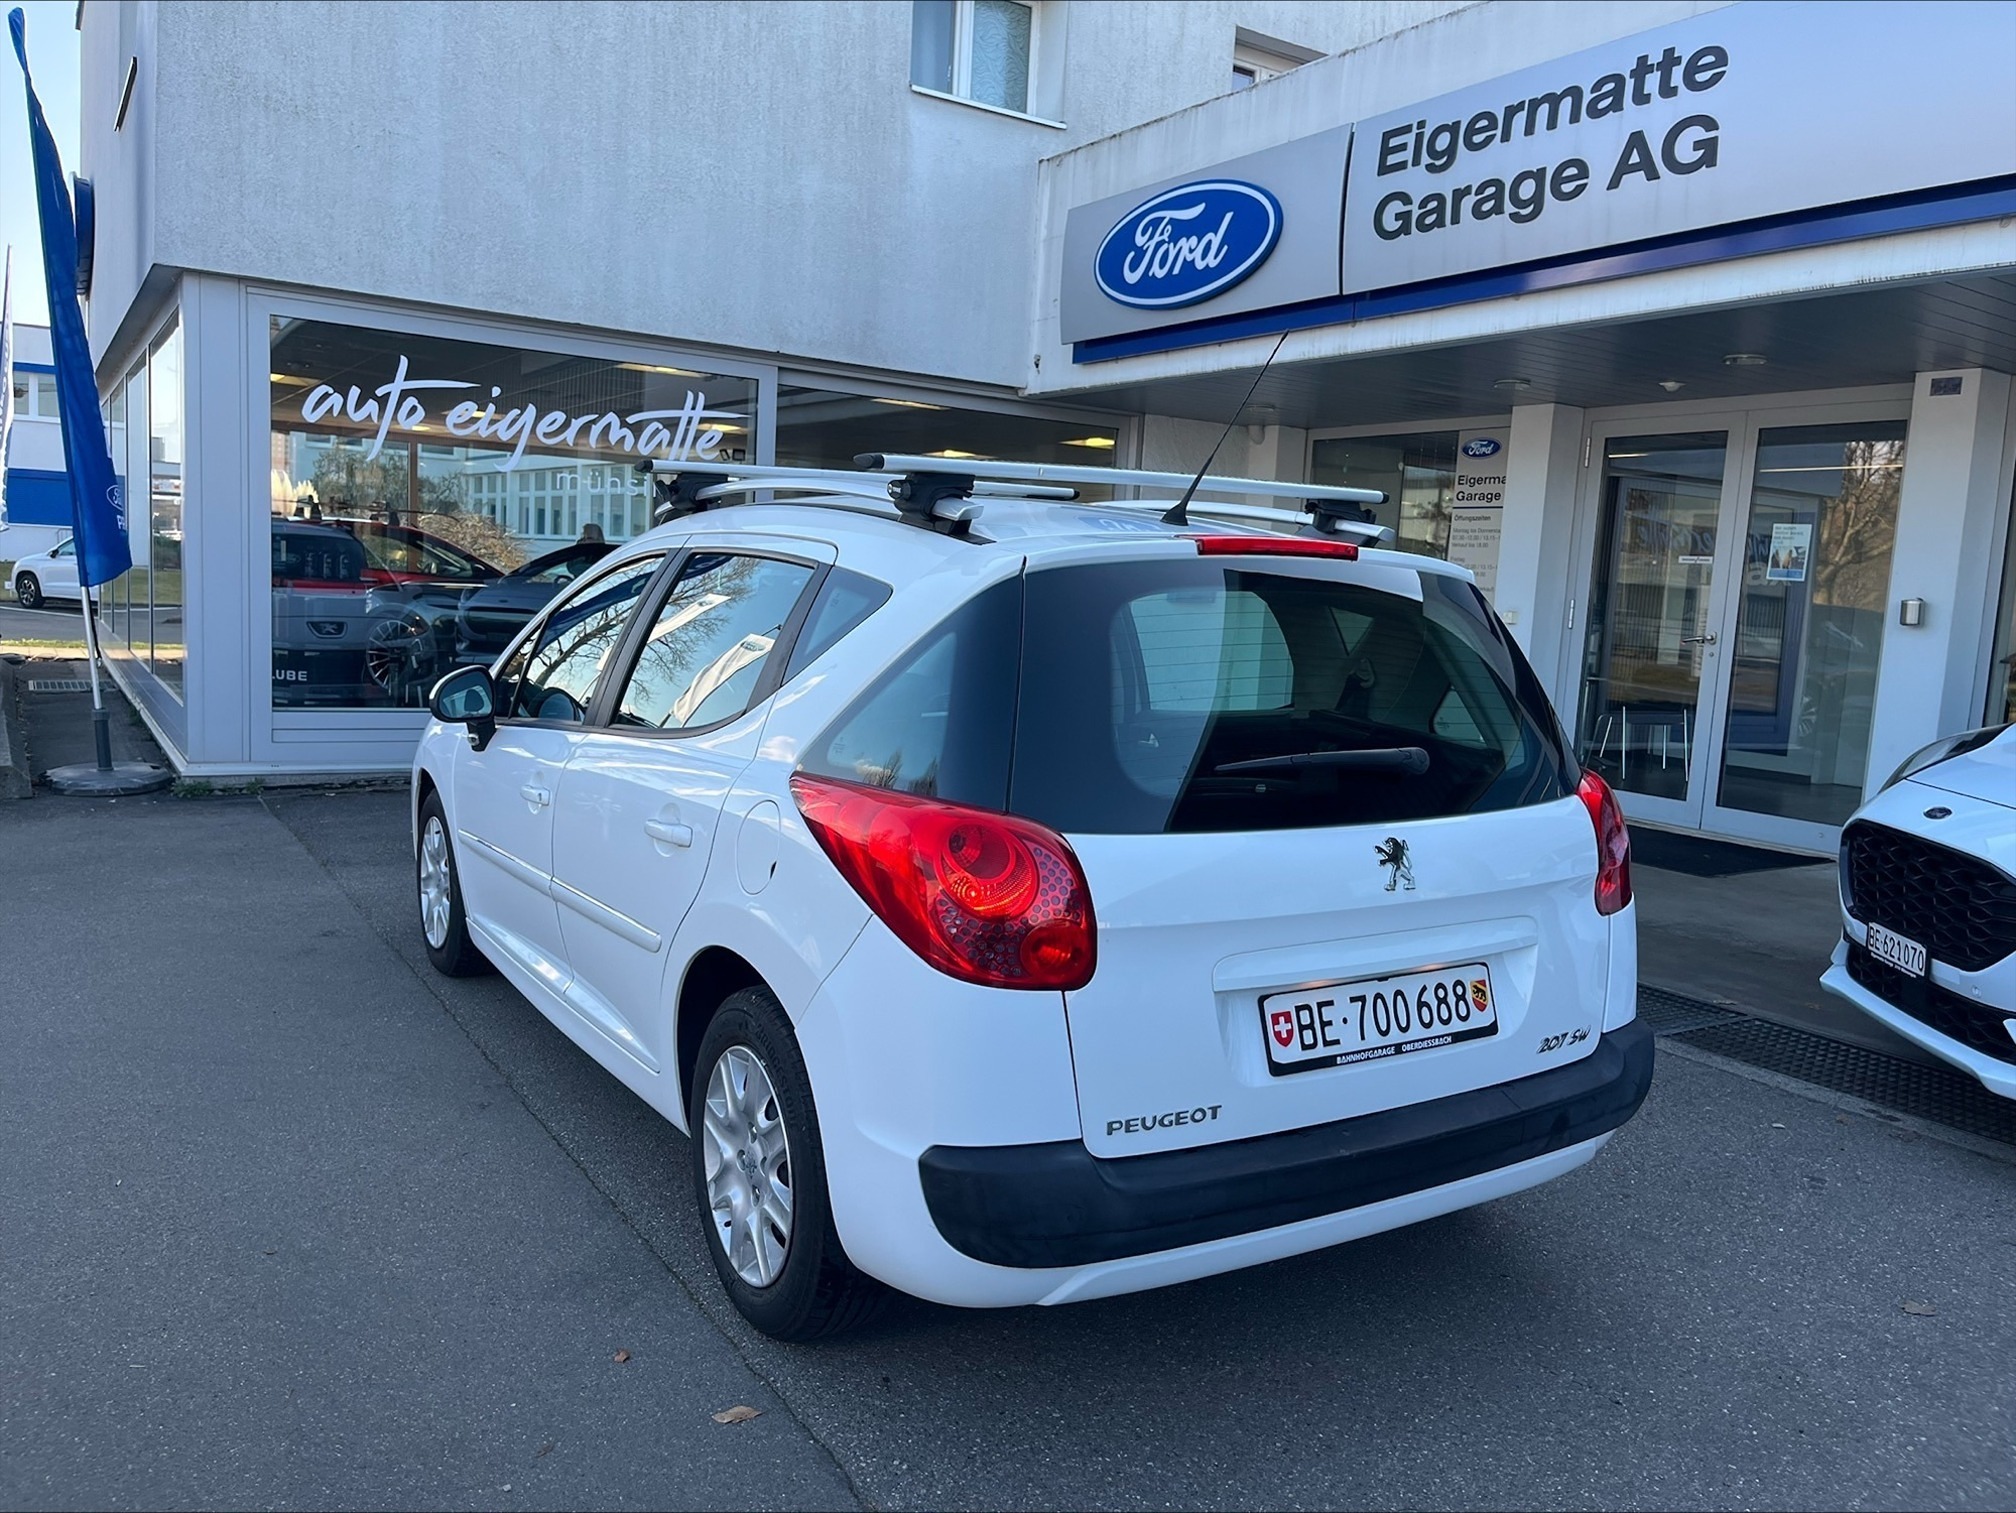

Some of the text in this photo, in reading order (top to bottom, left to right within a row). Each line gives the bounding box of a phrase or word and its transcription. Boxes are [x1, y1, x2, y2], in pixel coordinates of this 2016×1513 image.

[1377, 44, 1730, 177] Eigermatte
[1372, 114, 1721, 242] Garage AG
[1122, 202, 1235, 285] Ford
[301, 355, 752, 472] auto eigermatte
[1468, 440, 1494, 456] Ford
[1455, 490, 1502, 504] Garage
[1336, 1035, 1453, 1065] BAHNHOFGARAGE OBERDIESSBACH
[1536, 1024, 1592, 1055] 207 SW
[1105, 1104, 1223, 1136] PEUGEOT
